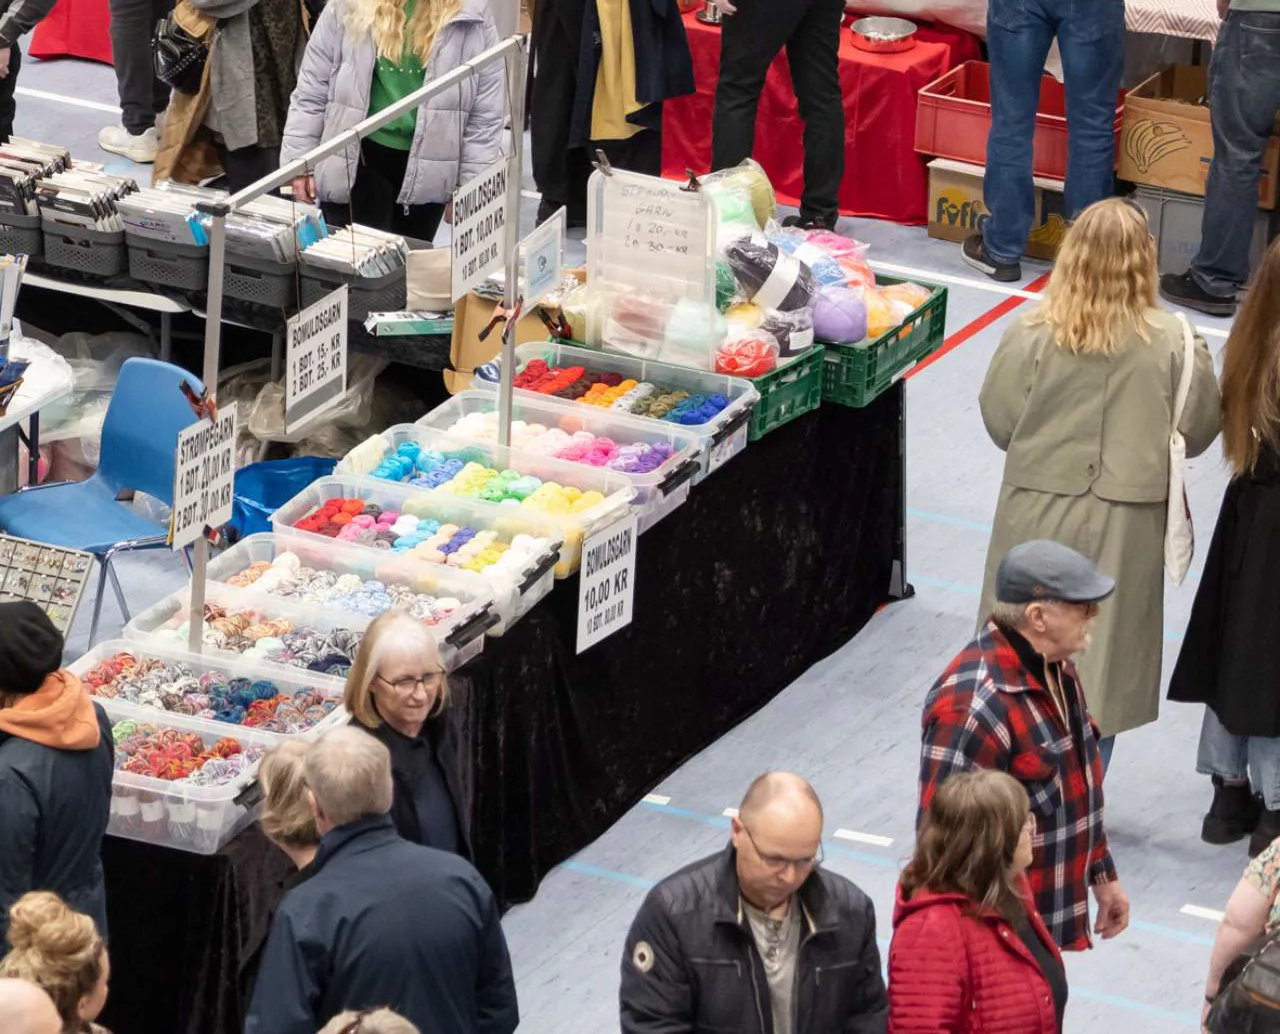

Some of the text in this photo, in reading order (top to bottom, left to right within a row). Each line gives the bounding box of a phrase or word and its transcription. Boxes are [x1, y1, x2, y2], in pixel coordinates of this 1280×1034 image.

[454, 166, 506, 227] BOMULDSGARN
[635, 204, 675, 218] GARN
[460, 228, 475, 255] BDT.
[477, 213, 493, 244] 10,00
[292, 301, 341, 349] BOMULDSGARN
[292, 379, 297, 397] 2
[299, 369, 314, 393] BDT.
[331, 351, 341, 371] KR
[299, 351, 314, 373] BDT.
[331, 333, 341, 352] KR
[180, 413, 234, 466] STRØMPEGARN
[185, 465, 201, 496] BDT.
[221, 448, 231, 477] KR
[176, 510, 182, 533] 2
[182, 501, 199, 529] BDT.
[220, 482, 231, 508] KR
[585, 527, 632, 578] BOMULDSGARN
[585, 567, 628, 613] 10,00 KR
[617, 599, 624, 618] KR
